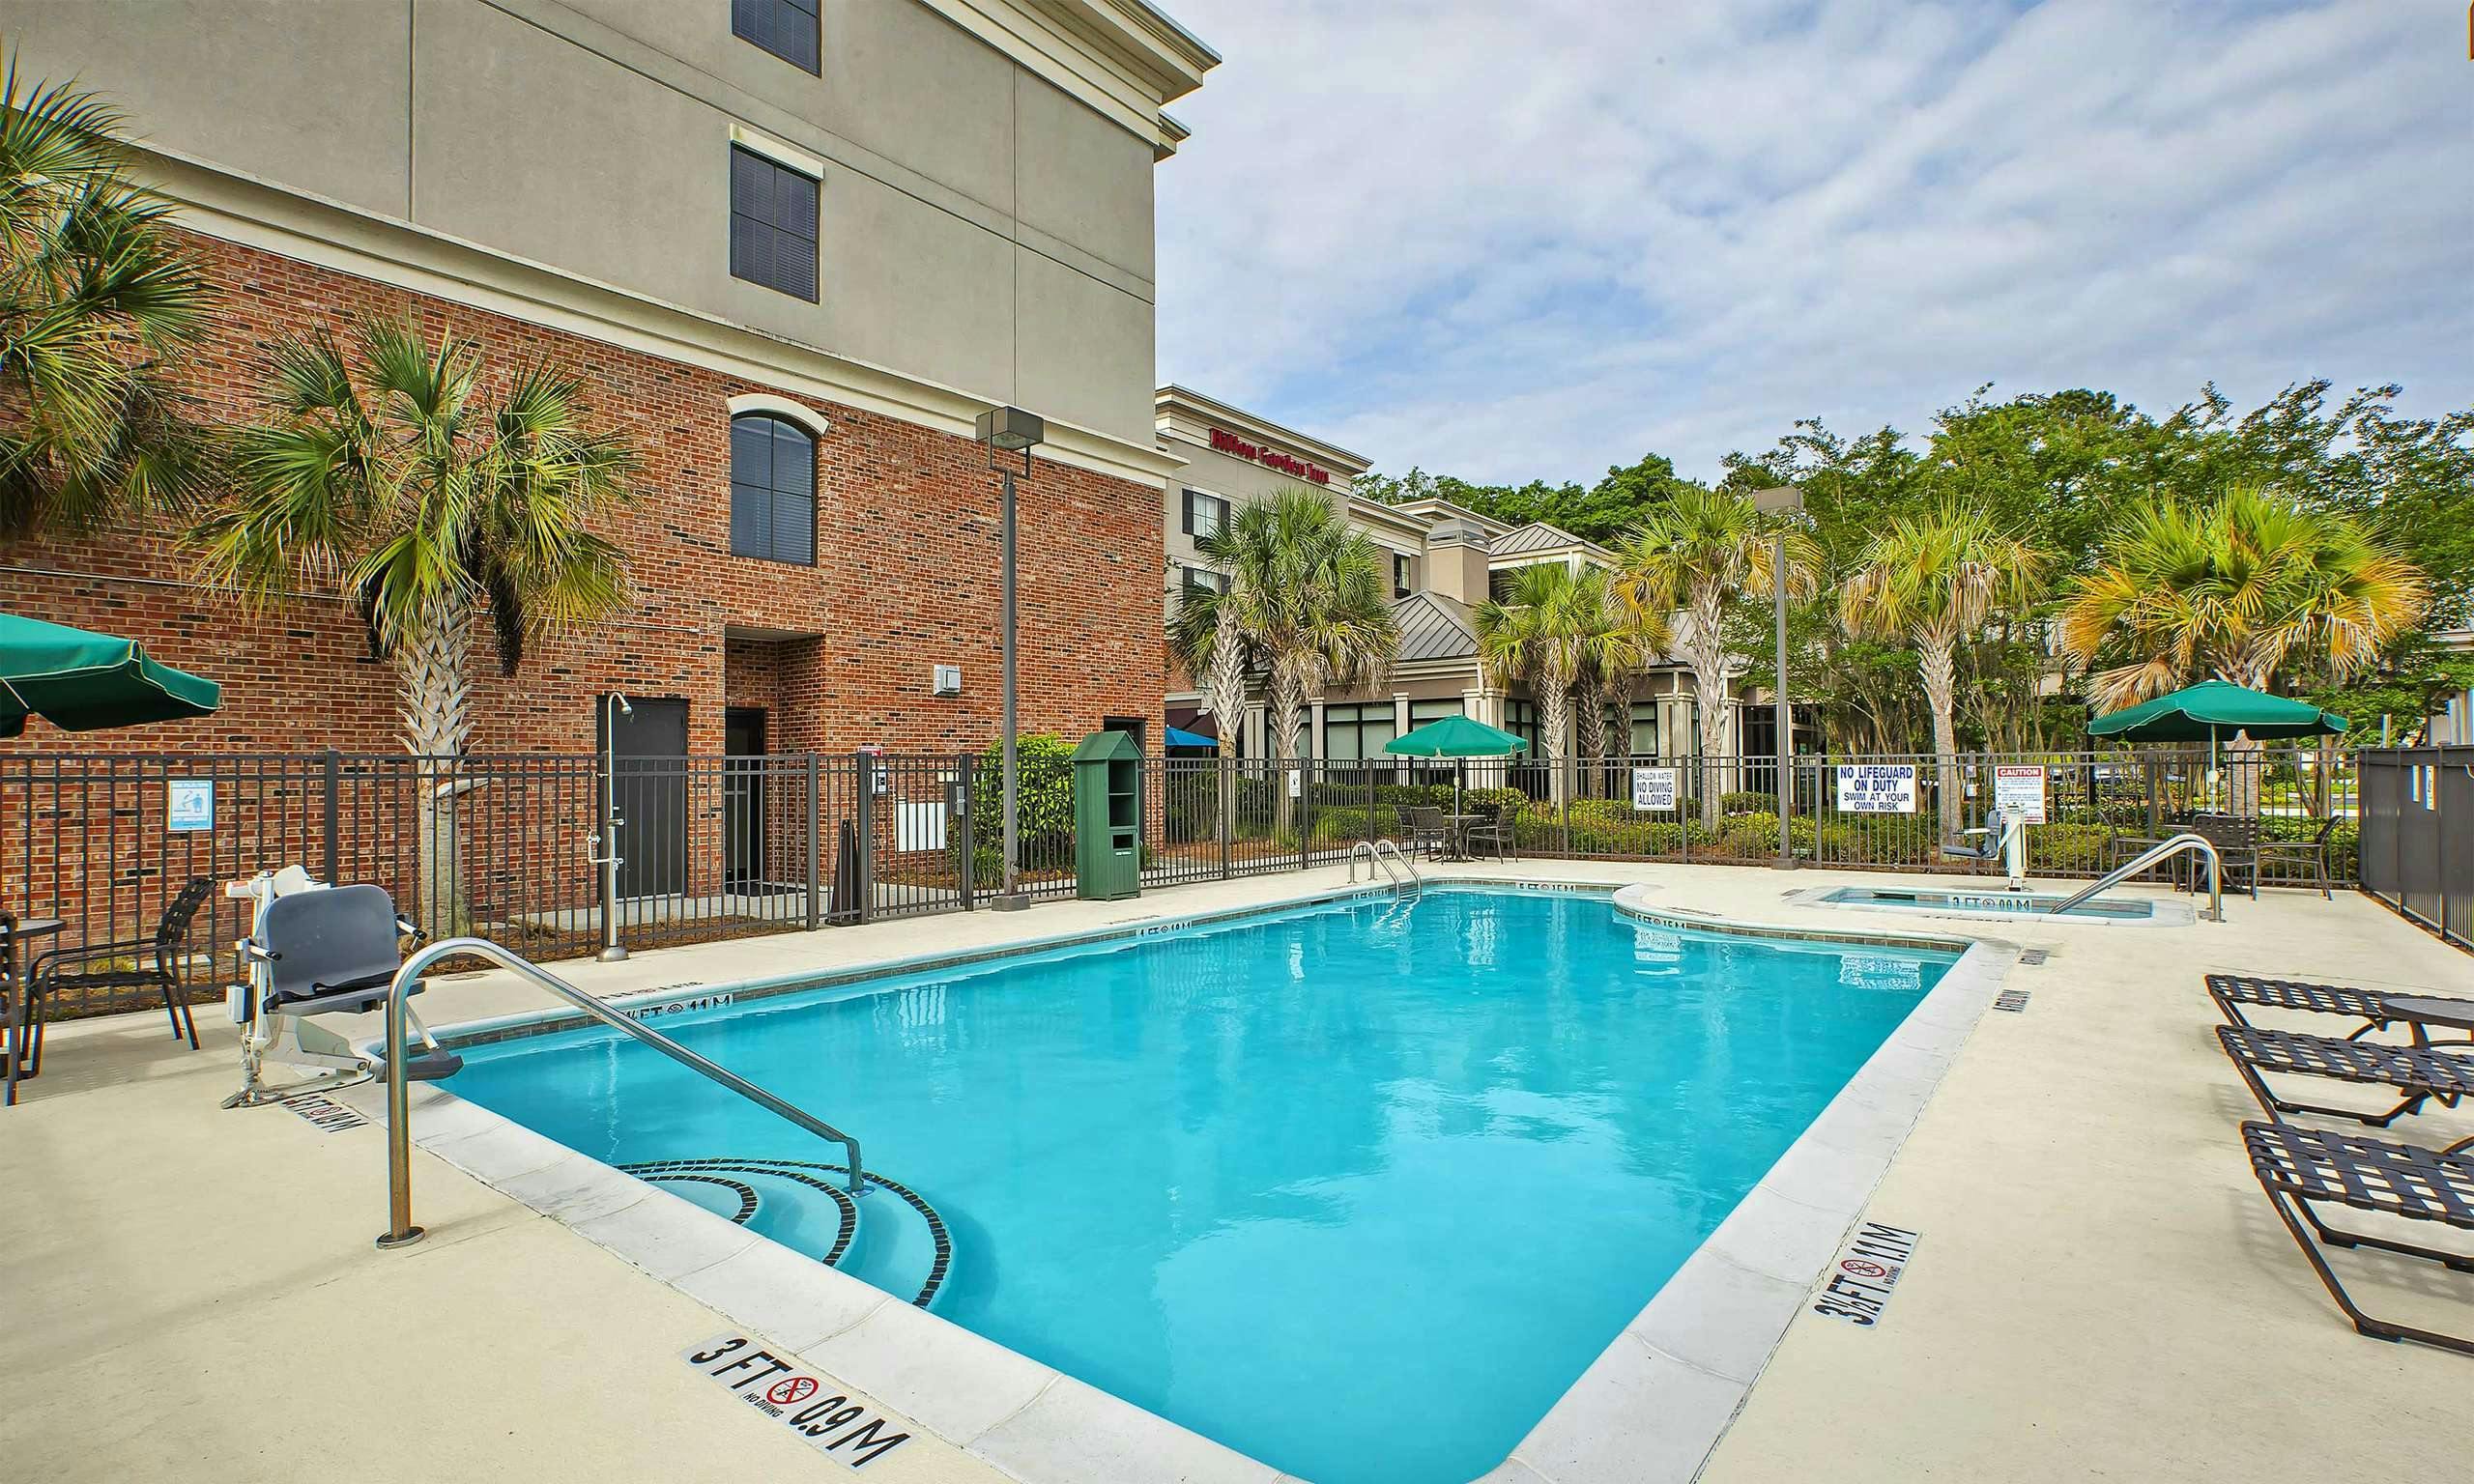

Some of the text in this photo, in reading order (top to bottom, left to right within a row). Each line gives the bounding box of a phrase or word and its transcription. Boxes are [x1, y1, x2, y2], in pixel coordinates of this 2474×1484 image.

[1840, 766, 1913, 779] NO LIFEGUARD
[1636, 782, 1673, 793] NO DIVING
[1854, 780, 1899, 791] ON DUTY
[1638, 794, 1673, 806] ALLOWED
[1844, 792, 1910, 802] SWIM AT YOUR
[1854, 802, 1899, 811] OWN RISK
[690, 1337, 748, 1364] 3
[710, 1351, 794, 1390] FT
[742, 1392, 785, 1418] NO DIVING
